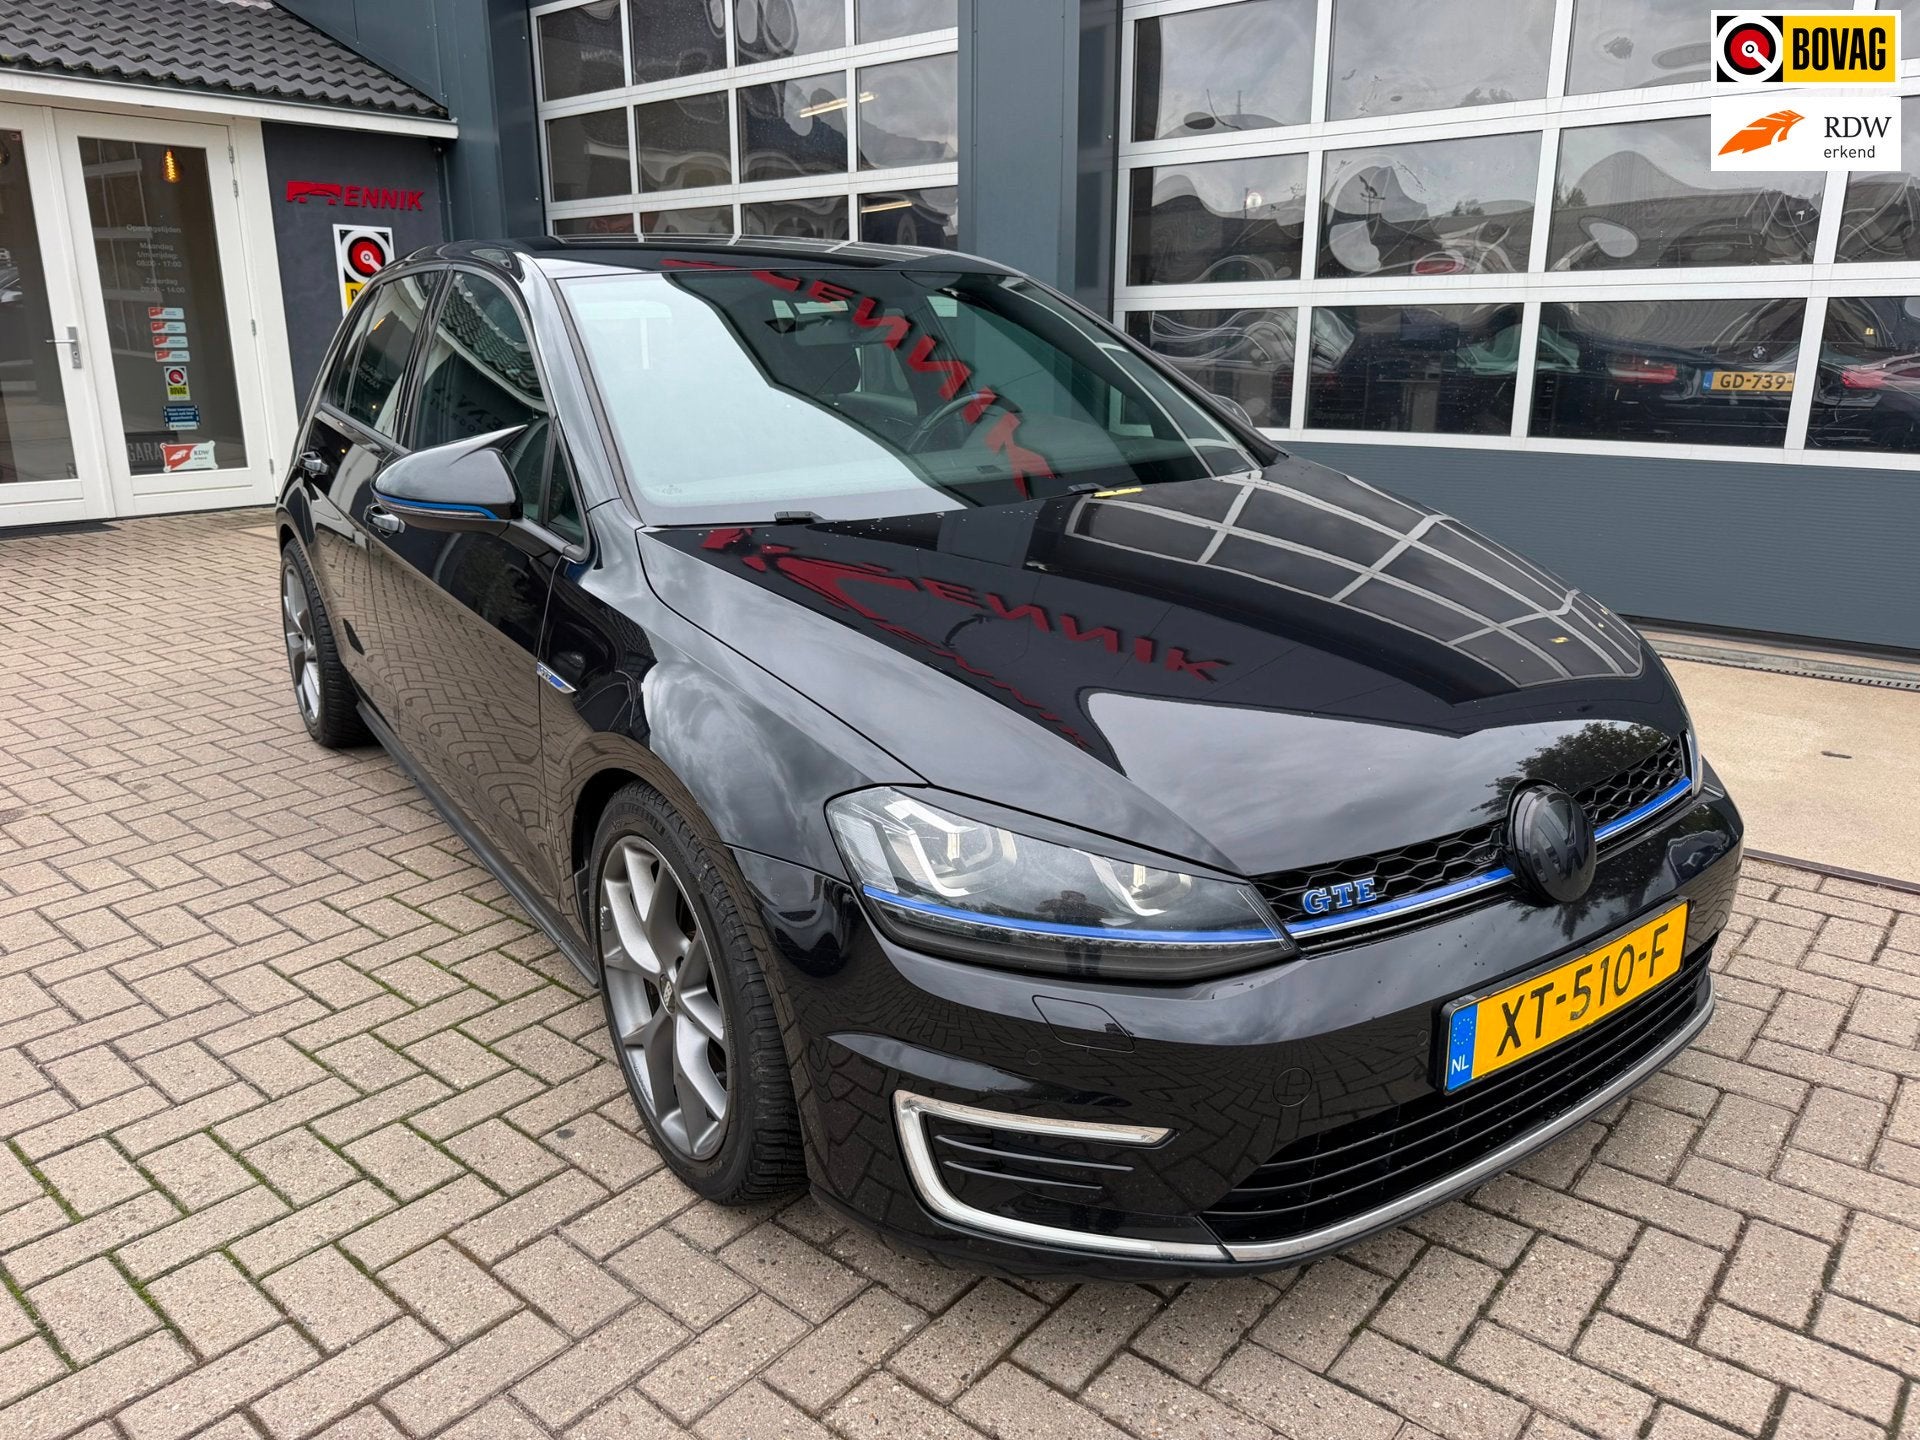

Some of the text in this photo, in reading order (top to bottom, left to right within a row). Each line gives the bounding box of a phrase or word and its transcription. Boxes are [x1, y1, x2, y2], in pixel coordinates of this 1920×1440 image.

[126, 224, 182, 234] Openingstijden
[1303, 877, 1378, 915] GTE
[1496, 922, 1670, 1058] XT-510-F
[1451, 1054, 1470, 1076] NL
